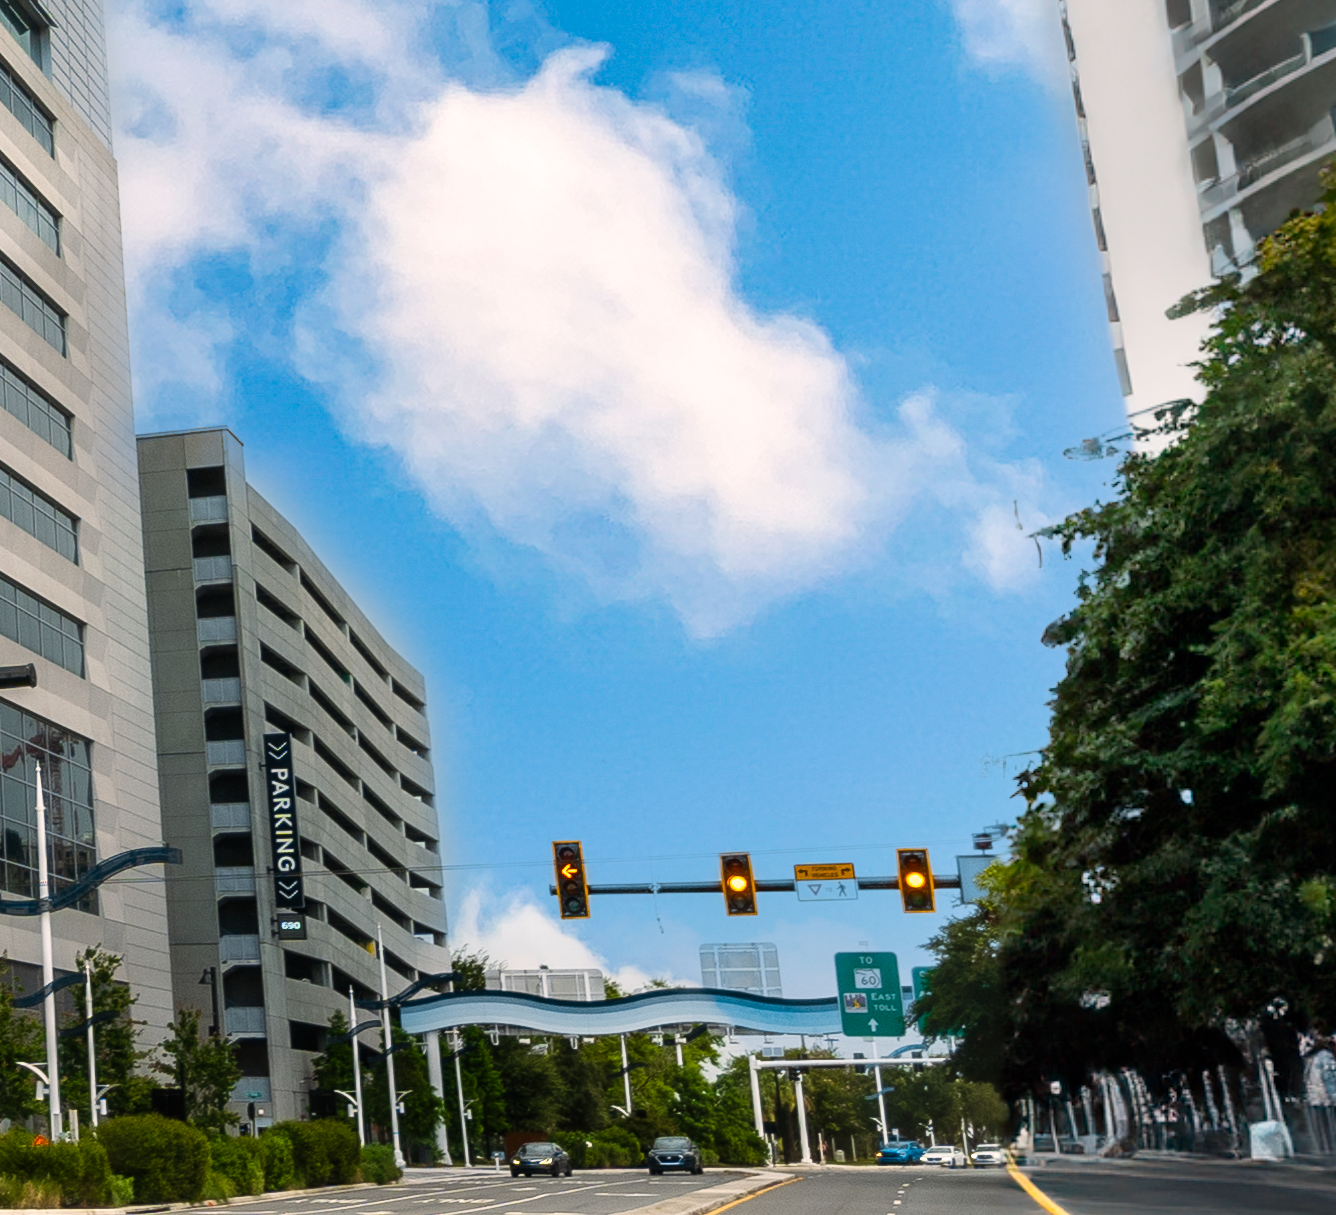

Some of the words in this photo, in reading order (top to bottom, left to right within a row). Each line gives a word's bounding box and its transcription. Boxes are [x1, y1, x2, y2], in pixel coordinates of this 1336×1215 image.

[270, 768, 296, 872] PARKING
[859, 956, 873, 964] TO
[861, 976, 877, 985] 60
